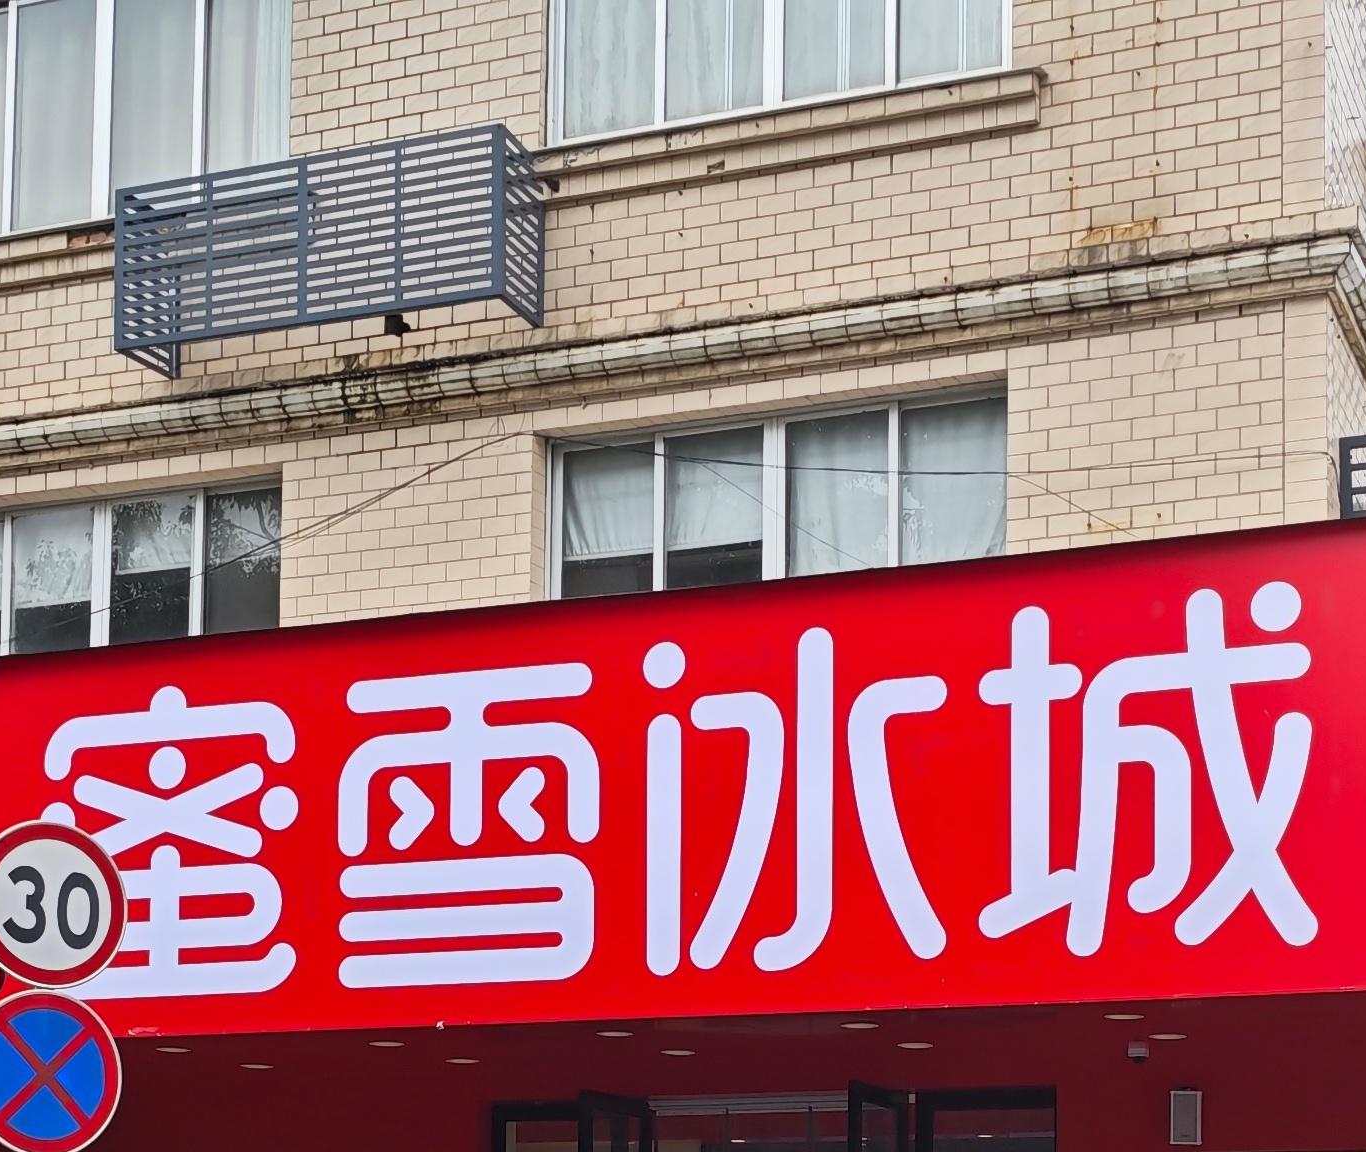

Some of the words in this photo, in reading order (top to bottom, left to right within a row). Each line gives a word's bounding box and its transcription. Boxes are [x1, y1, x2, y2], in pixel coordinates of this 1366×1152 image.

[1, 863, 101, 952] 30
[43, 580, 1319, 998] 蜜雪冰城
